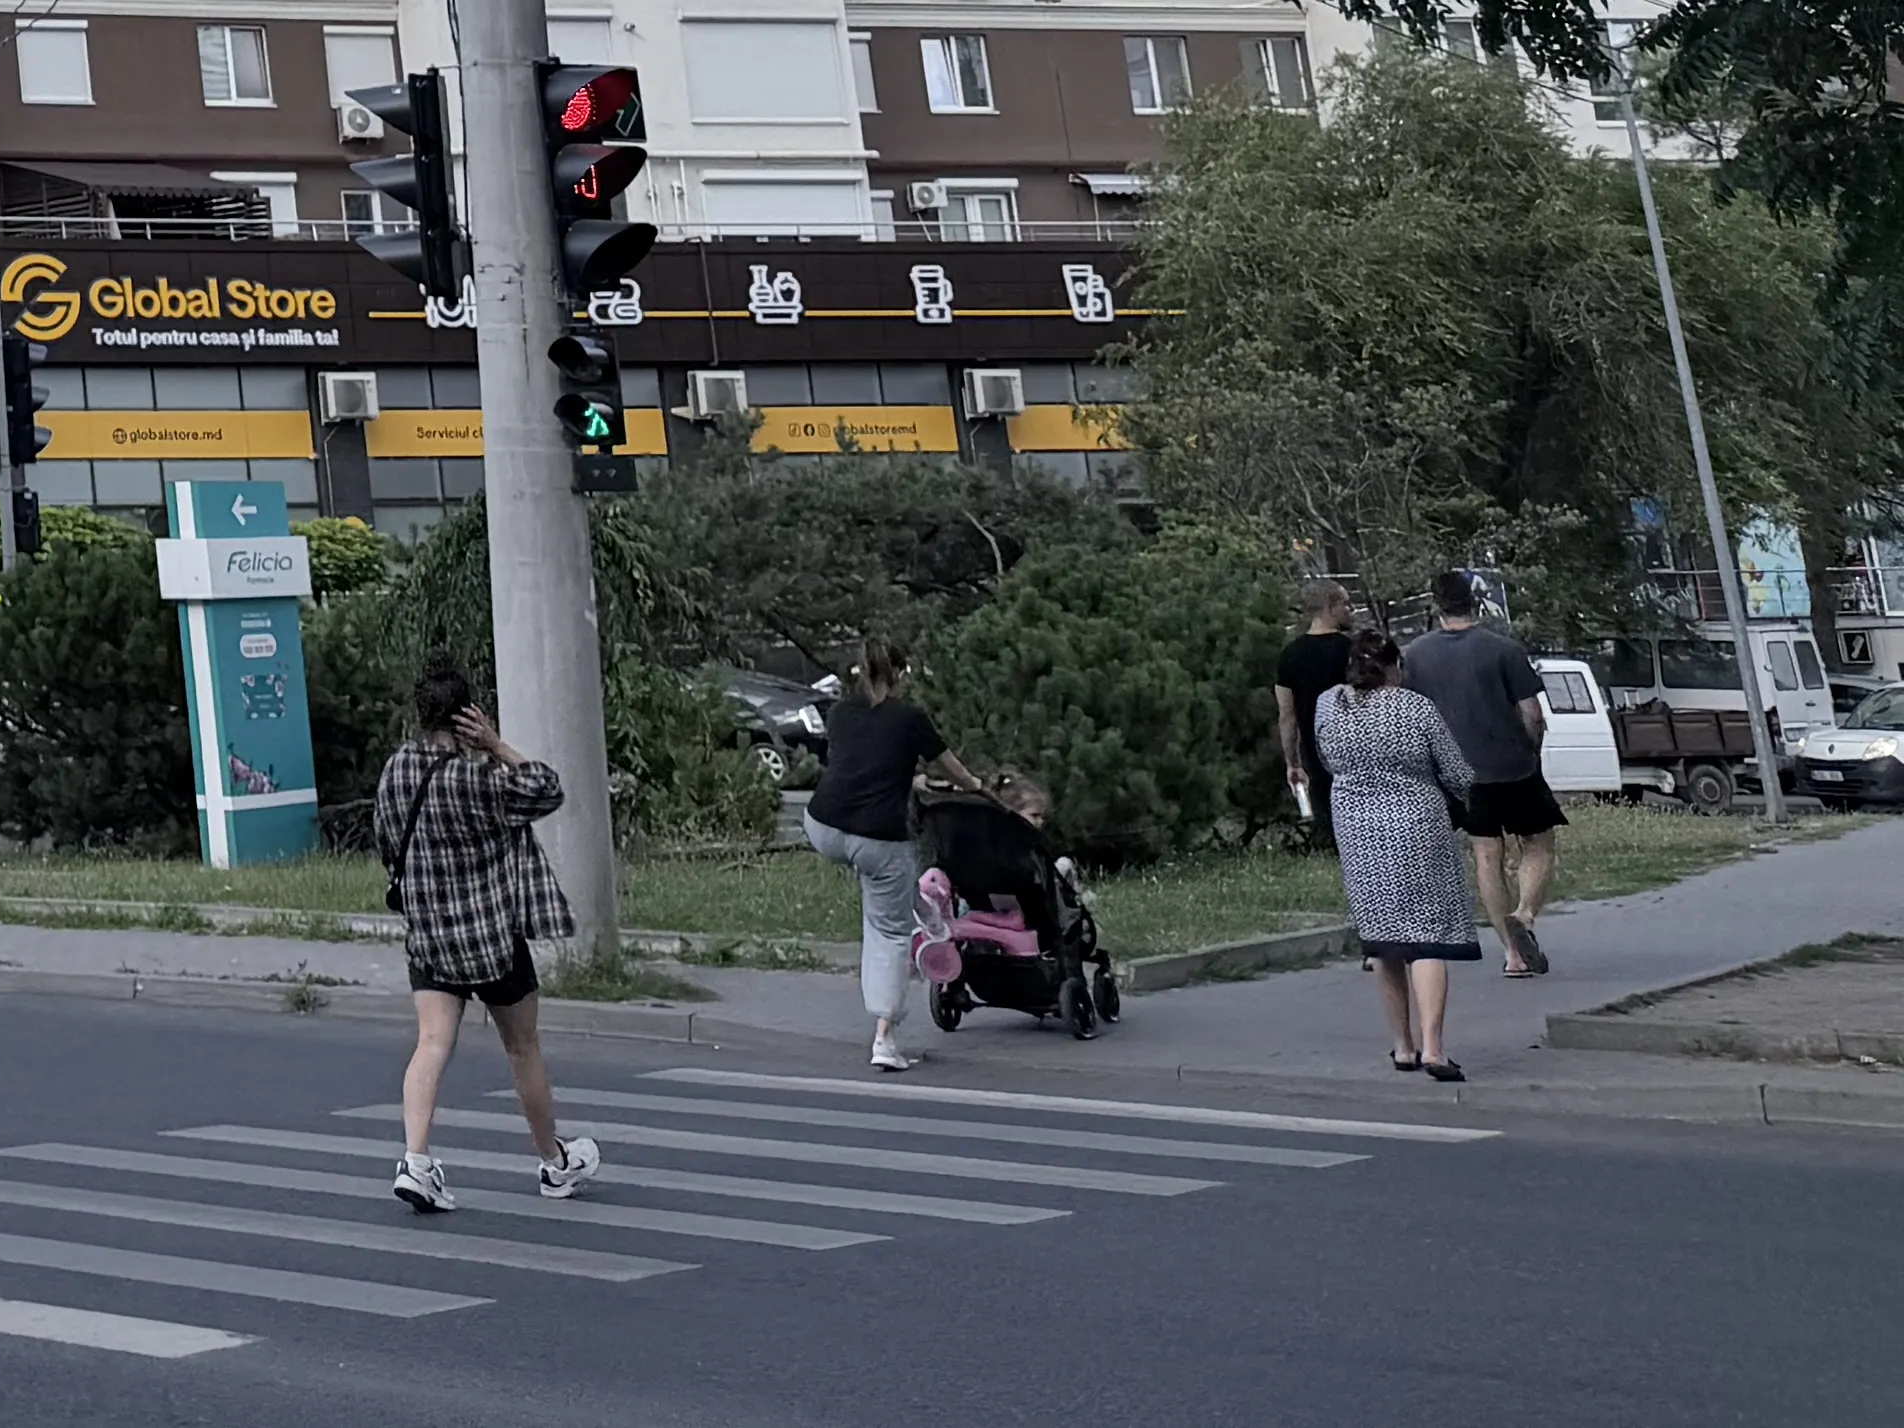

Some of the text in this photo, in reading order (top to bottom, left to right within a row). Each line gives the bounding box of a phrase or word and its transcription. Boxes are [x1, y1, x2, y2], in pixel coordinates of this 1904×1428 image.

[89, 276, 336, 319] Global Store
[92, 328, 138, 345] Totul
[140, 328, 197, 349] pentru
[199, 330, 239, 346] casa
[257, 328, 314, 346] familia
[129, 428, 223, 444] globalstore.md
[416, 425, 469, 439] Serviciul
[227, 550, 293, 574] Felicia
